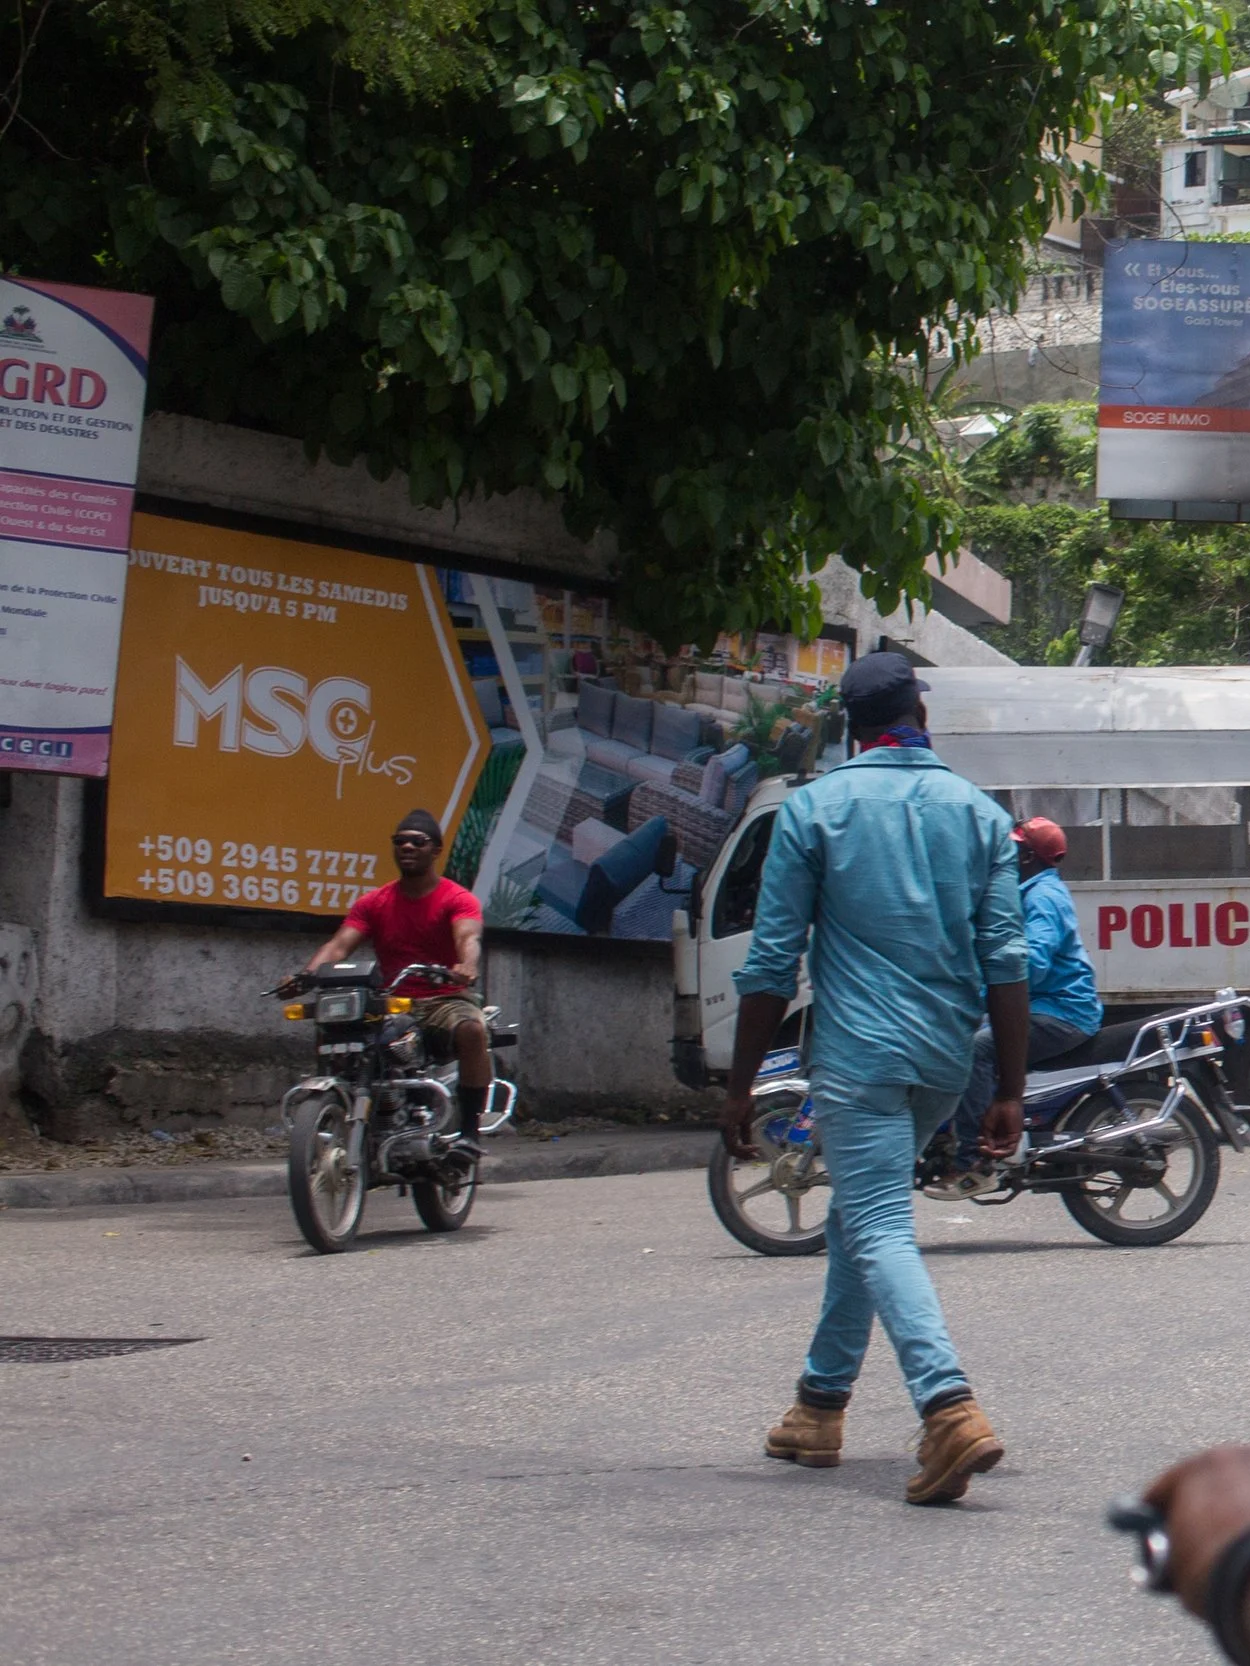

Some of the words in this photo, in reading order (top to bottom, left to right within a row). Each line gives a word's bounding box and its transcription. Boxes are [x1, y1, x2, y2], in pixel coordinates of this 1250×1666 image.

[1147, 263, 1161, 277] Et
[1213, 316, 1243, 327] Tower
[52, 412, 64, 422] ET
[68, 415, 82, 425] DE
[86, 417, 133, 432] GESTION
[1122, 411, 1166, 425] SOGE
[1168, 413, 1210, 426] IMMO
[15, 421, 36, 432] DES
[40, 423, 99, 440] DESASTRES
[48, 488, 69, 500] des
[48, 522, 64, 532] du
[11, 584, 24, 593] de
[26, 586, 37, 595] la
[39, 587, 88, 600] Protection
[90, 594, 118, 604] Civile
[215, 563, 273, 588] TOUS
[276, 573, 314, 596] LES
[318, 581, 409, 611] SAMEDIS
[198, 585, 282, 616] JUSQU'A
[284, 600, 298, 618] 5
[301, 602, 337, 624] PM
[173, 653, 372, 764] MSC
[336, 720, 417, 800] plus
[138, 834, 213, 865] +509
[220, 841, 298, 873] 2945
[304, 848, 379, 880] 7777
[137, 867, 215, 898] +509
[222, 873, 300, 905] 3656
